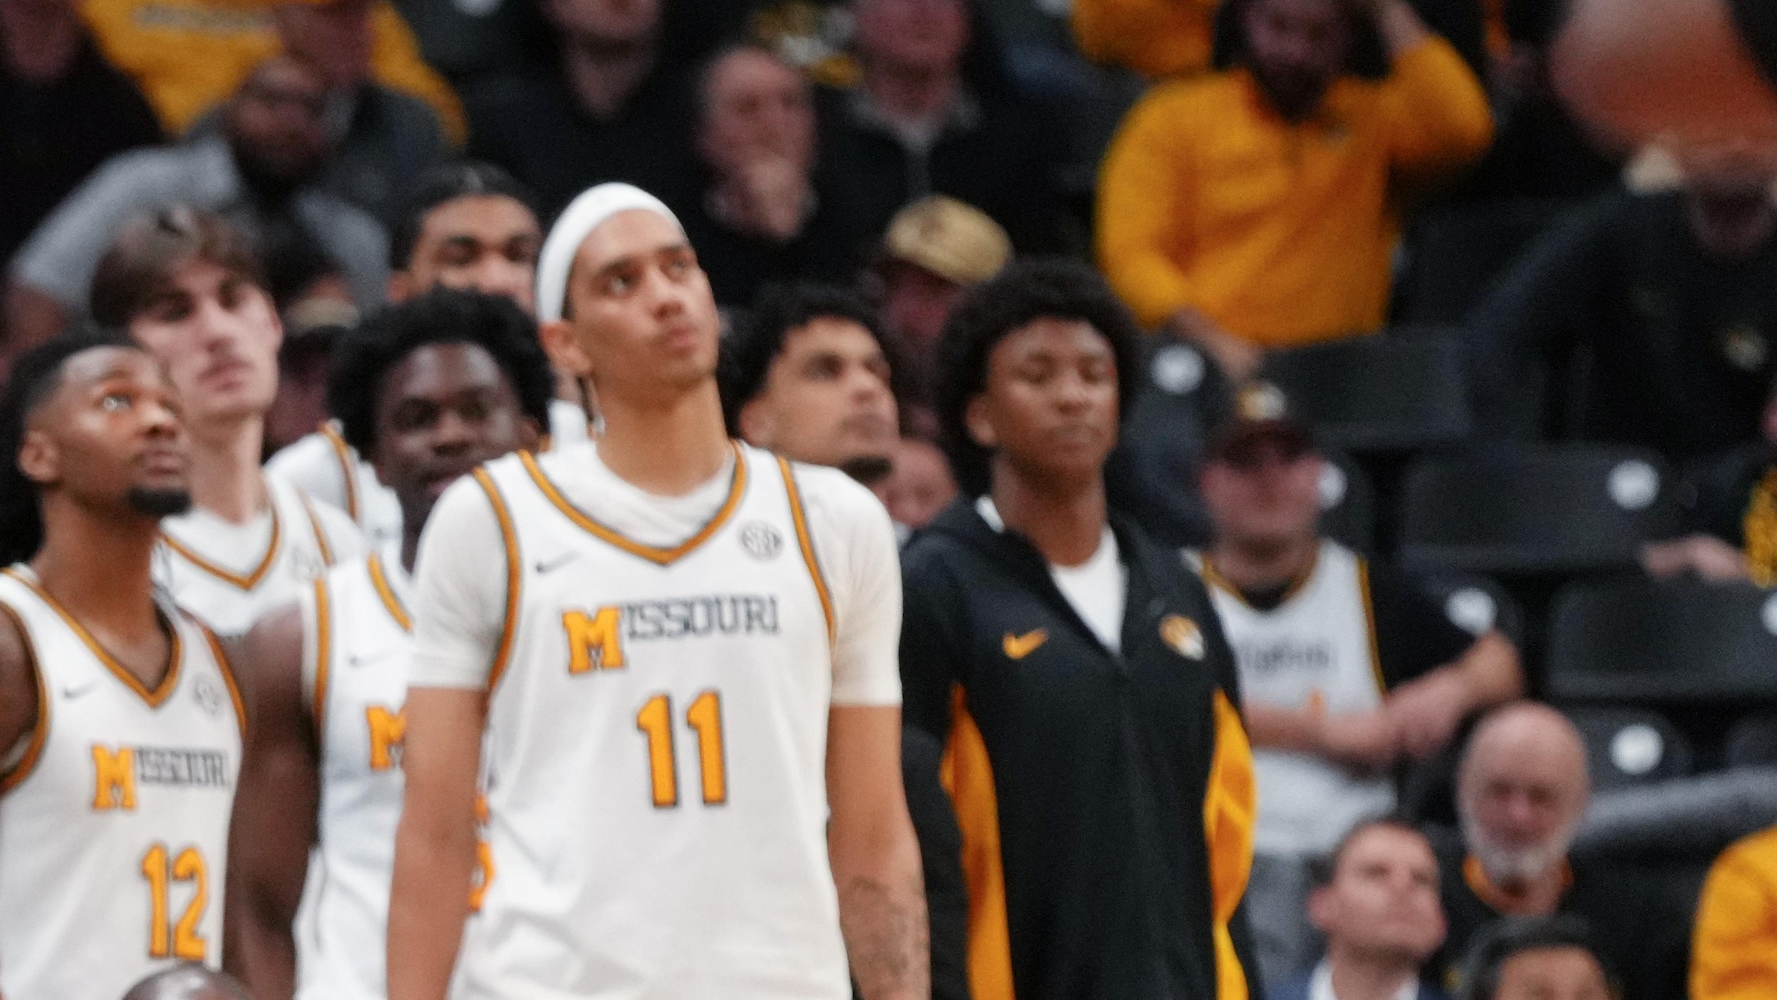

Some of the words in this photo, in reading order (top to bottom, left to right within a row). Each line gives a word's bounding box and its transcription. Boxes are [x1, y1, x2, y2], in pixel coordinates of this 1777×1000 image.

[562, 596, 780, 675] MISSOURI
[637, 690, 728, 808] 11
[141, 841, 209, 961] 12
